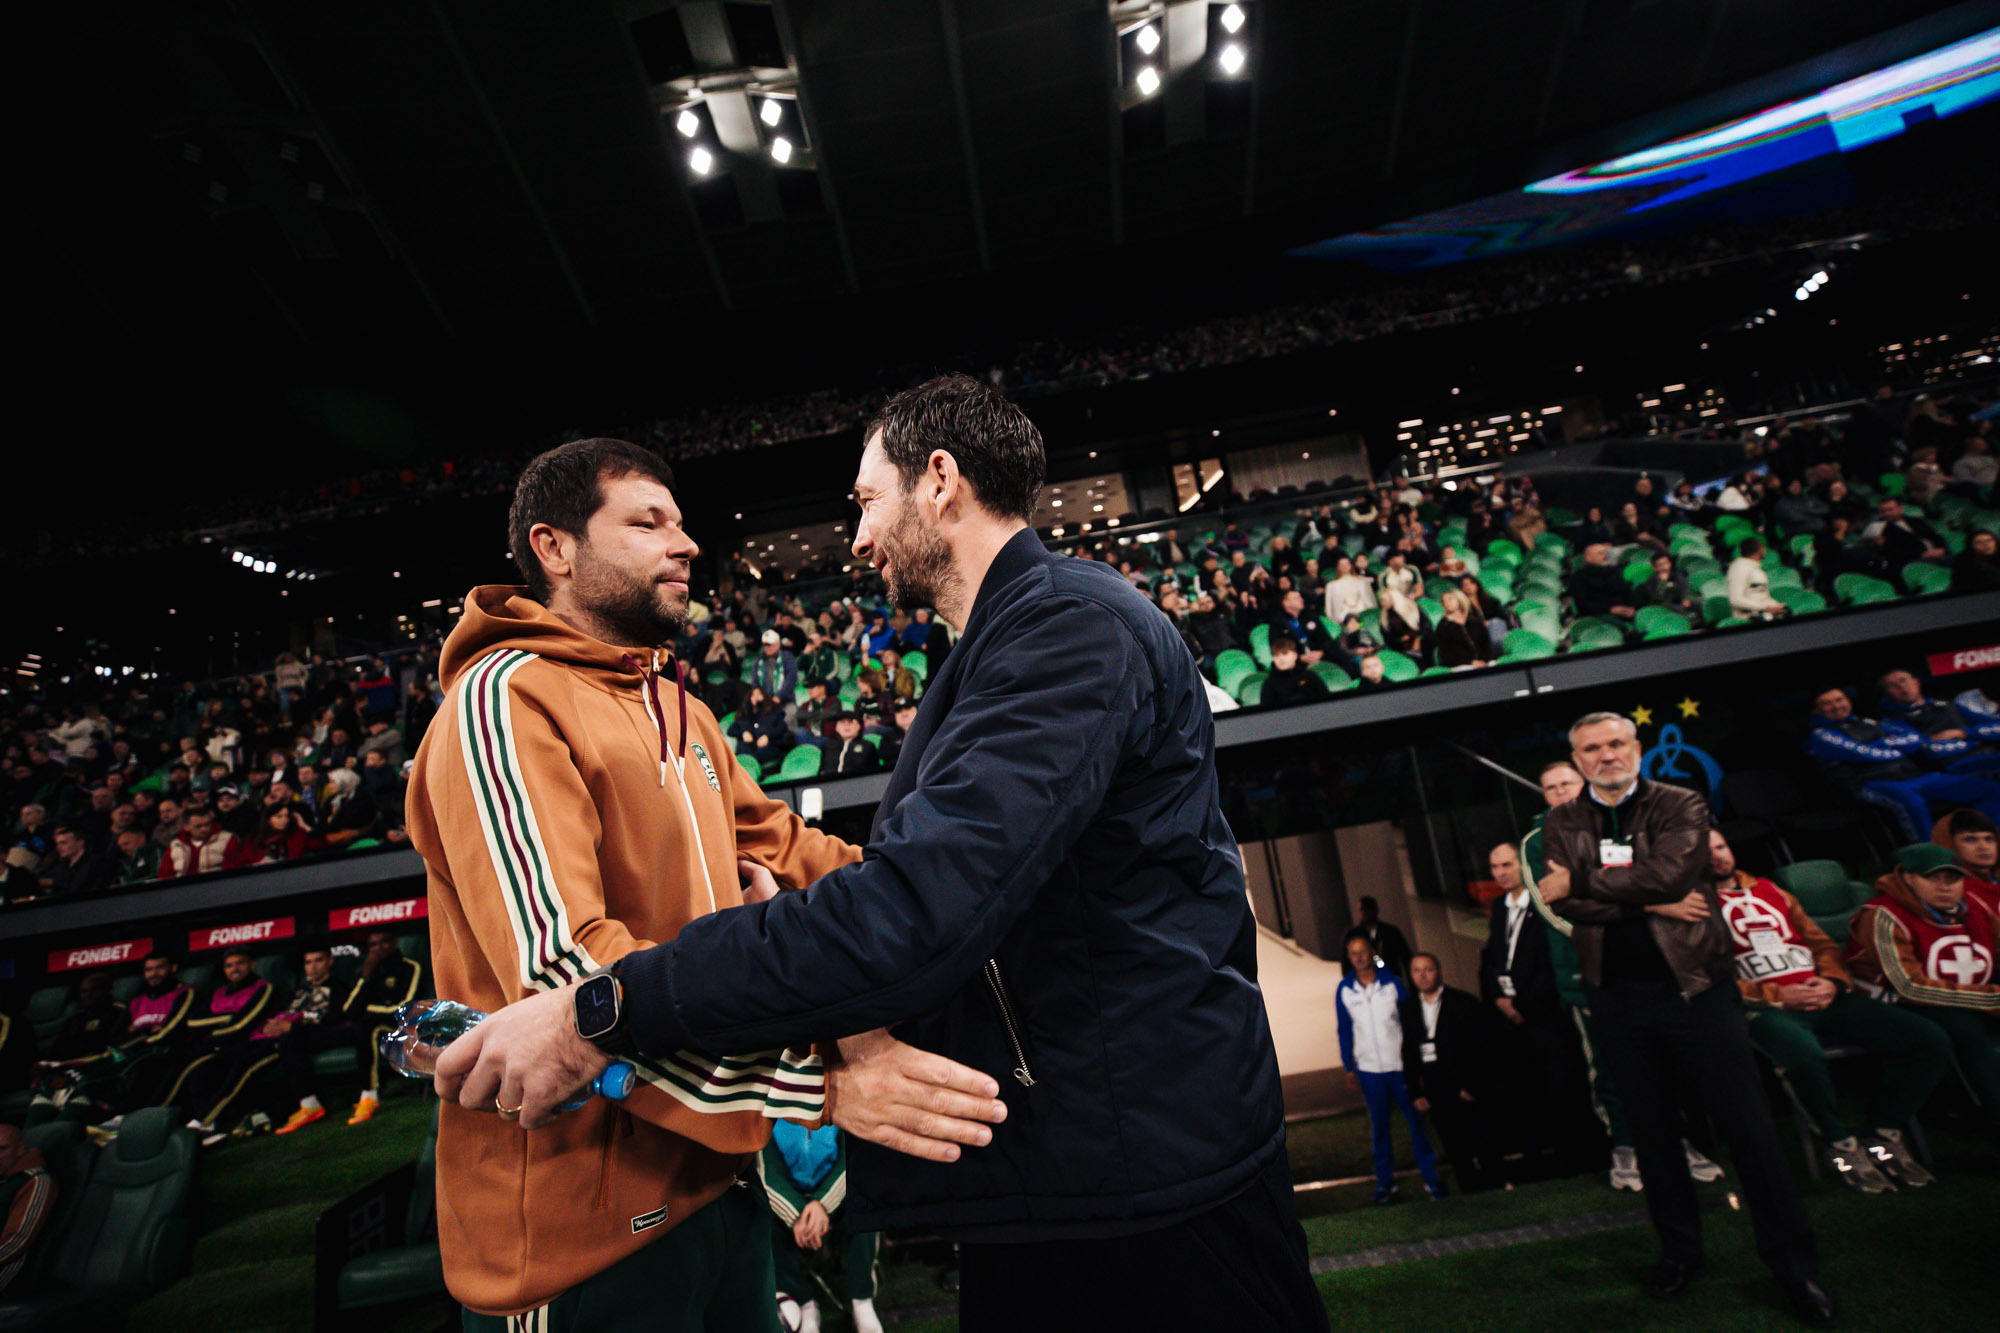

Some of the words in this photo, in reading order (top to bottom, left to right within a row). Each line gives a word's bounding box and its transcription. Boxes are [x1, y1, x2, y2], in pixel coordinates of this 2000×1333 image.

[348, 899, 417, 925] FONBET
[207, 920, 275, 946] FONBET
[67, 943, 133, 967] FONBET
